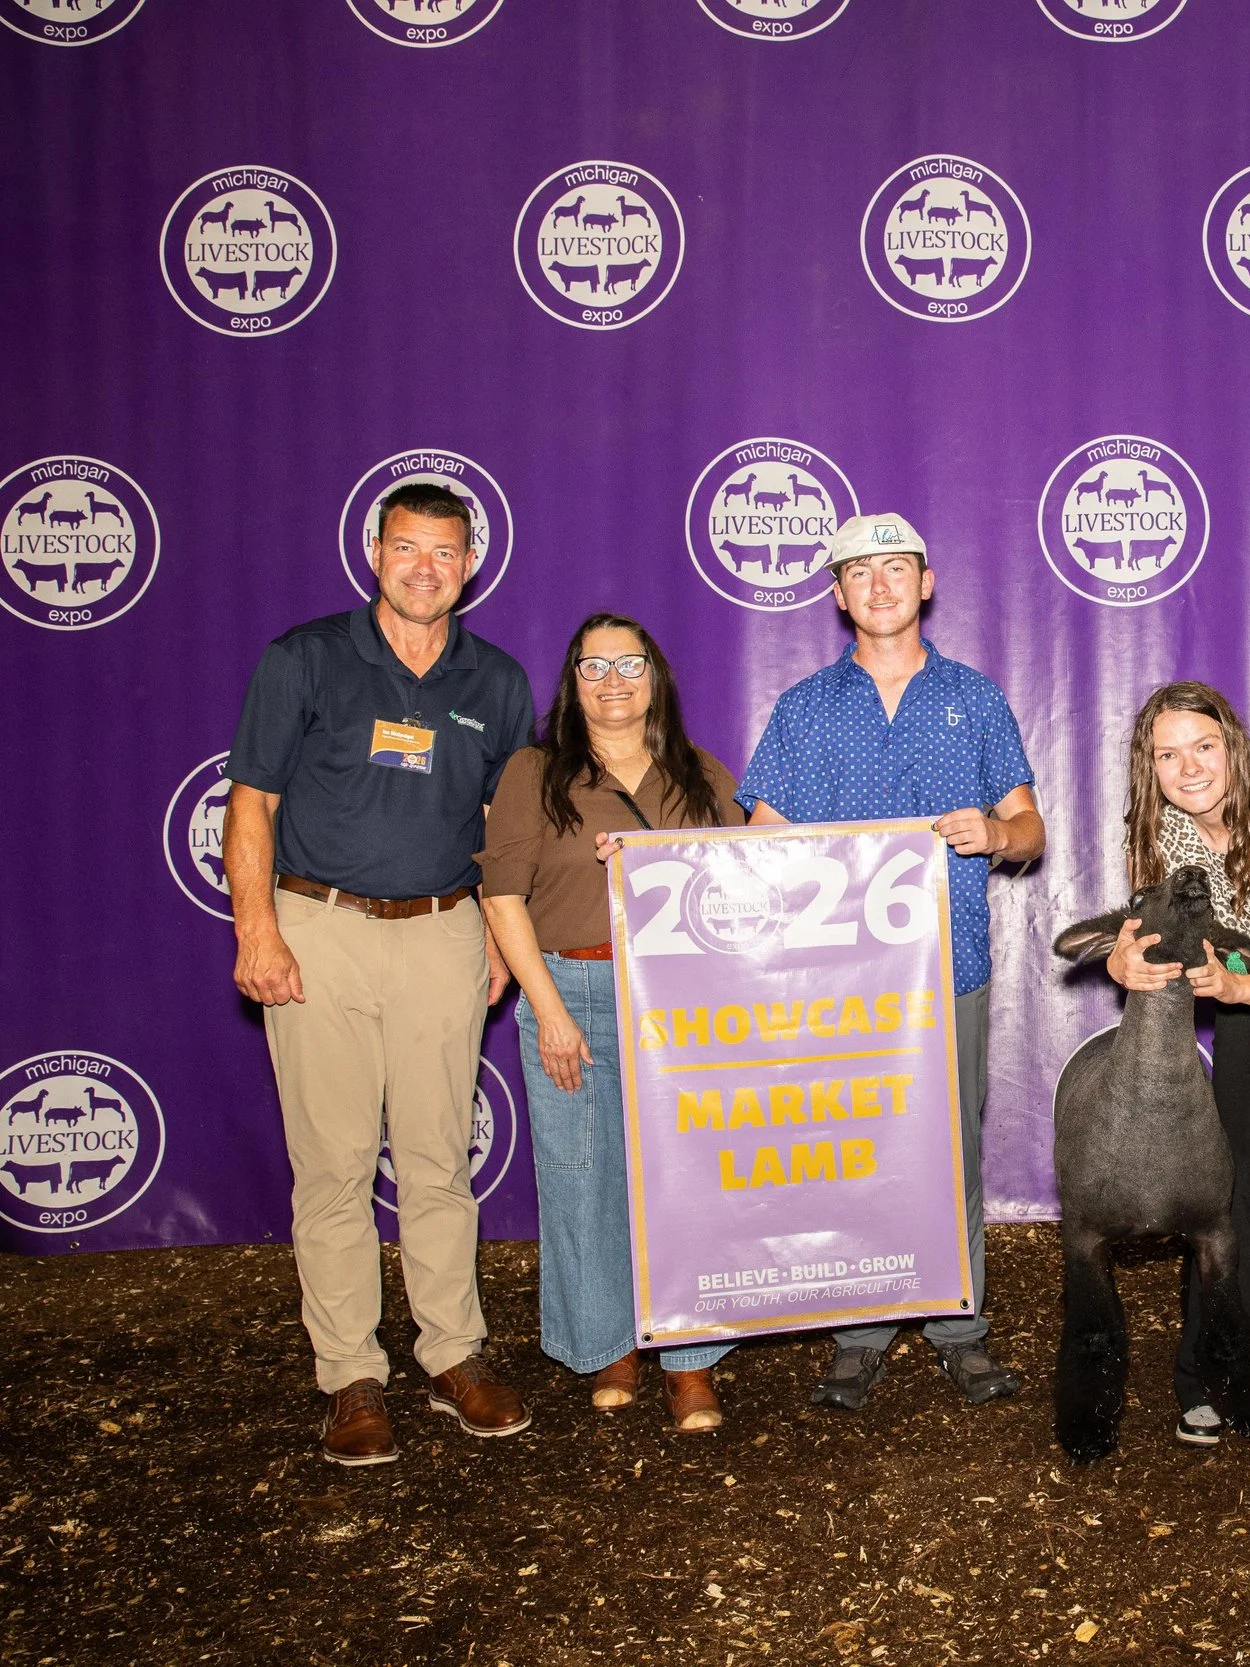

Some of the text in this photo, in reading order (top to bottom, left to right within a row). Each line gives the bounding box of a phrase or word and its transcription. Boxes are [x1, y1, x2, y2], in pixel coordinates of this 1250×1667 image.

[44, 25, 87, 41] expo
[407, 24, 446, 42] expo
[753, 21, 792, 38] expo
[1095, 23, 1133, 37] expo
[565, 166, 638, 186] michigan
[910, 159, 982, 183] michigan
[213, 171, 288, 192] michigan
[541, 235, 658, 255] LIVESTOCK
[888, 230, 1004, 251] LIVESTOCK
[188, 243, 309, 262] LIVESTOCK
[583, 310, 622, 325] expo
[928, 302, 967, 317] expo
[231, 317, 271, 332] expo
[735, 443, 812, 465] michigan
[1087, 440, 1160, 461] michigan
[31, 461, 109, 482] michigan
[390, 454, 465, 476] michigan
[711, 516, 834, 536] LIVESTOCK
[1065, 512, 1183, 532] LIVESTOCK
[4, 535, 132, 553] LIVESTOCK
[754, 591, 795, 606] expo
[1108, 586, 1147, 601] expo
[49, 610, 91, 625] expo
[638, 990, 936, 1050] SHOWCASE
[25, 1056, 111, 1079] michigan
[676, 1073, 914, 1133] MARKET
[719, 1138, 878, 1191] LAMB
[39, 1209, 87, 1227] expo
[698, 1253, 915, 1291] BELIEVE BUILD GROW
[694, 1277, 922, 1313] OUR YOUTH, OUR AGRICULTURE
